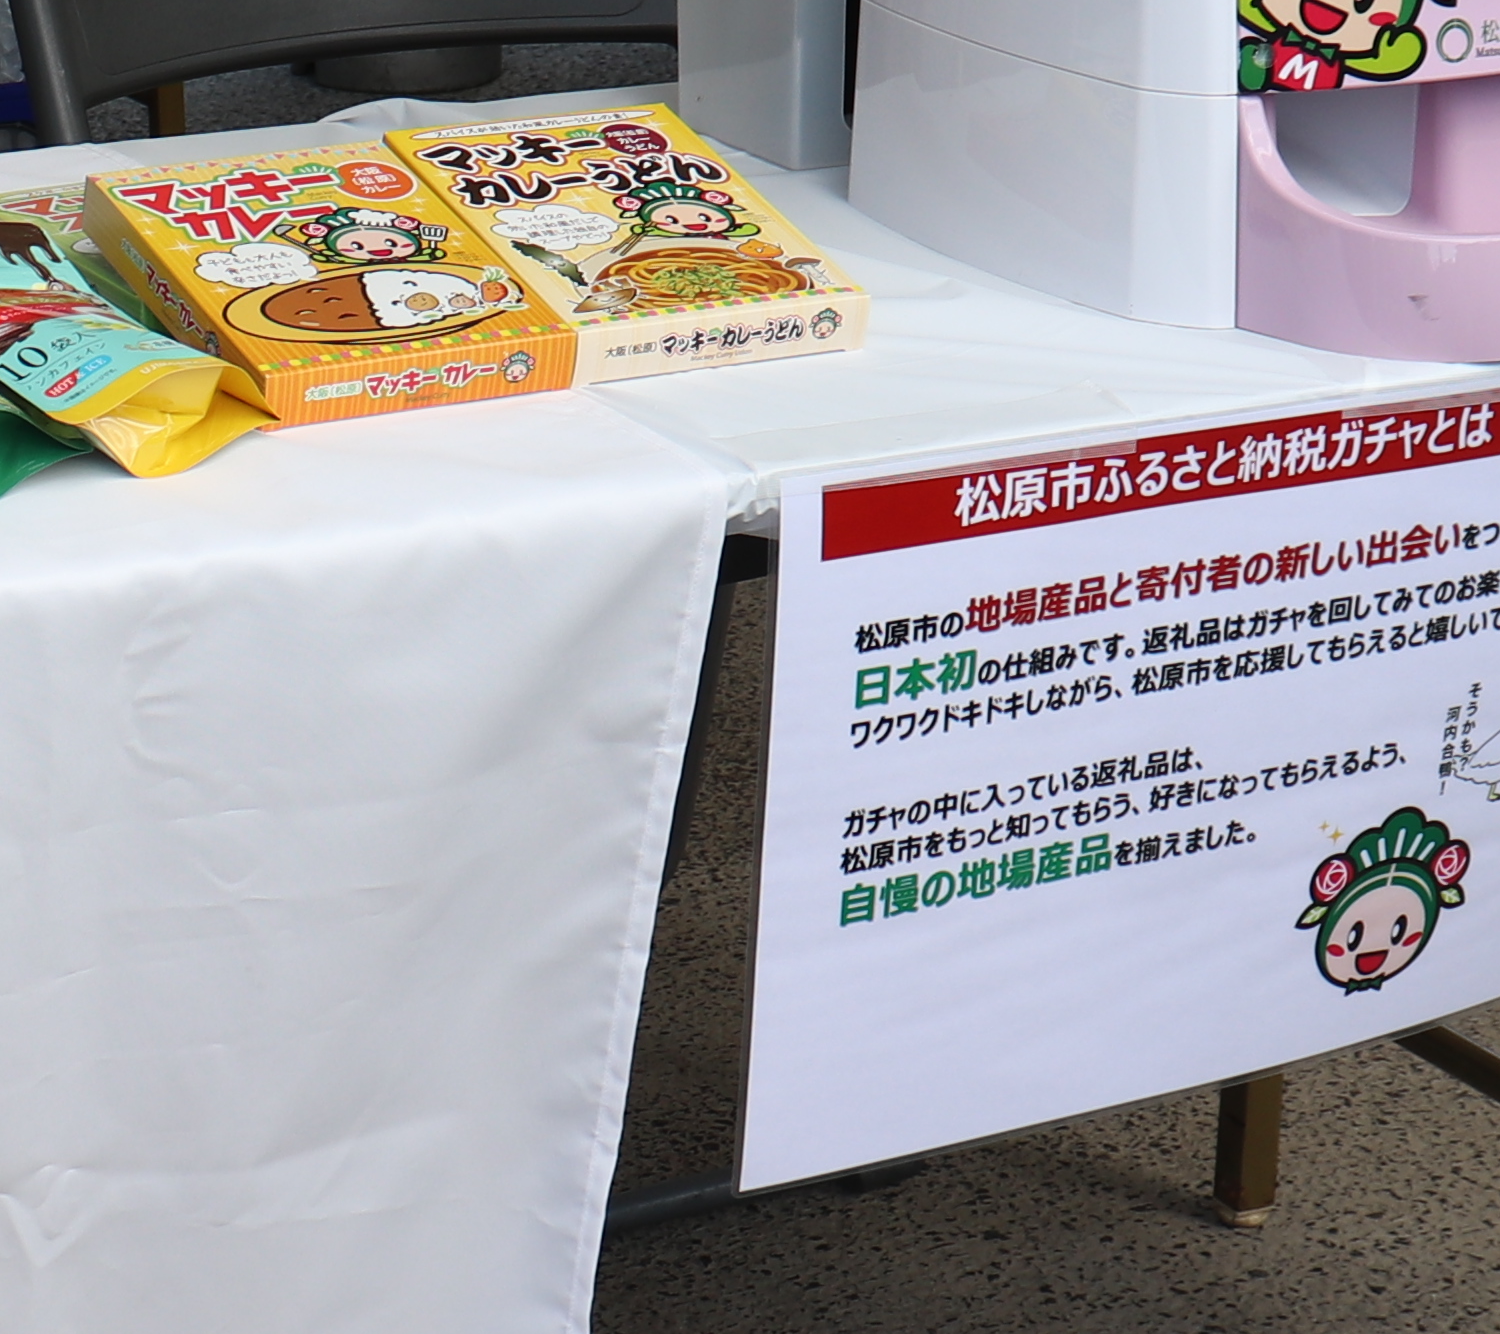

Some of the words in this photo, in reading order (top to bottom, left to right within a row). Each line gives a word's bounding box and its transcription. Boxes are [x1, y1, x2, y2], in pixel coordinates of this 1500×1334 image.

[417, 133, 608, 173] マッキー
[616, 136, 650, 146] カレー
[623, 143, 661, 152] うどん
[116, 169, 340, 216] マッキー
[351, 166, 383, 178] 大阪
[361, 183, 402, 196] カレー
[449, 154, 732, 208] カレーうどん
[172, 203, 338, 243] カレー
[660, 331, 719, 356] マッキー
[720, 316, 806, 348] カレーうどん
[25, 340, 107, 392] ノンカフェイン
[49, 376, 77, 399] HOT
[85, 356, 109, 375] ICE
[366, 367, 440, 399] マッキー
[442, 360, 496, 387] カレー
[1460, 682, 1482, 772] そうかも?
[840, 742, 1407, 877] 松原市をもっと知ってもらう、好きになってもらえるよう、
[842, 747, 1205, 838] ガチャの中に入っている返礼品は、
[839, 824, 1258, 927] 自慢の地場産品を揃えました。
